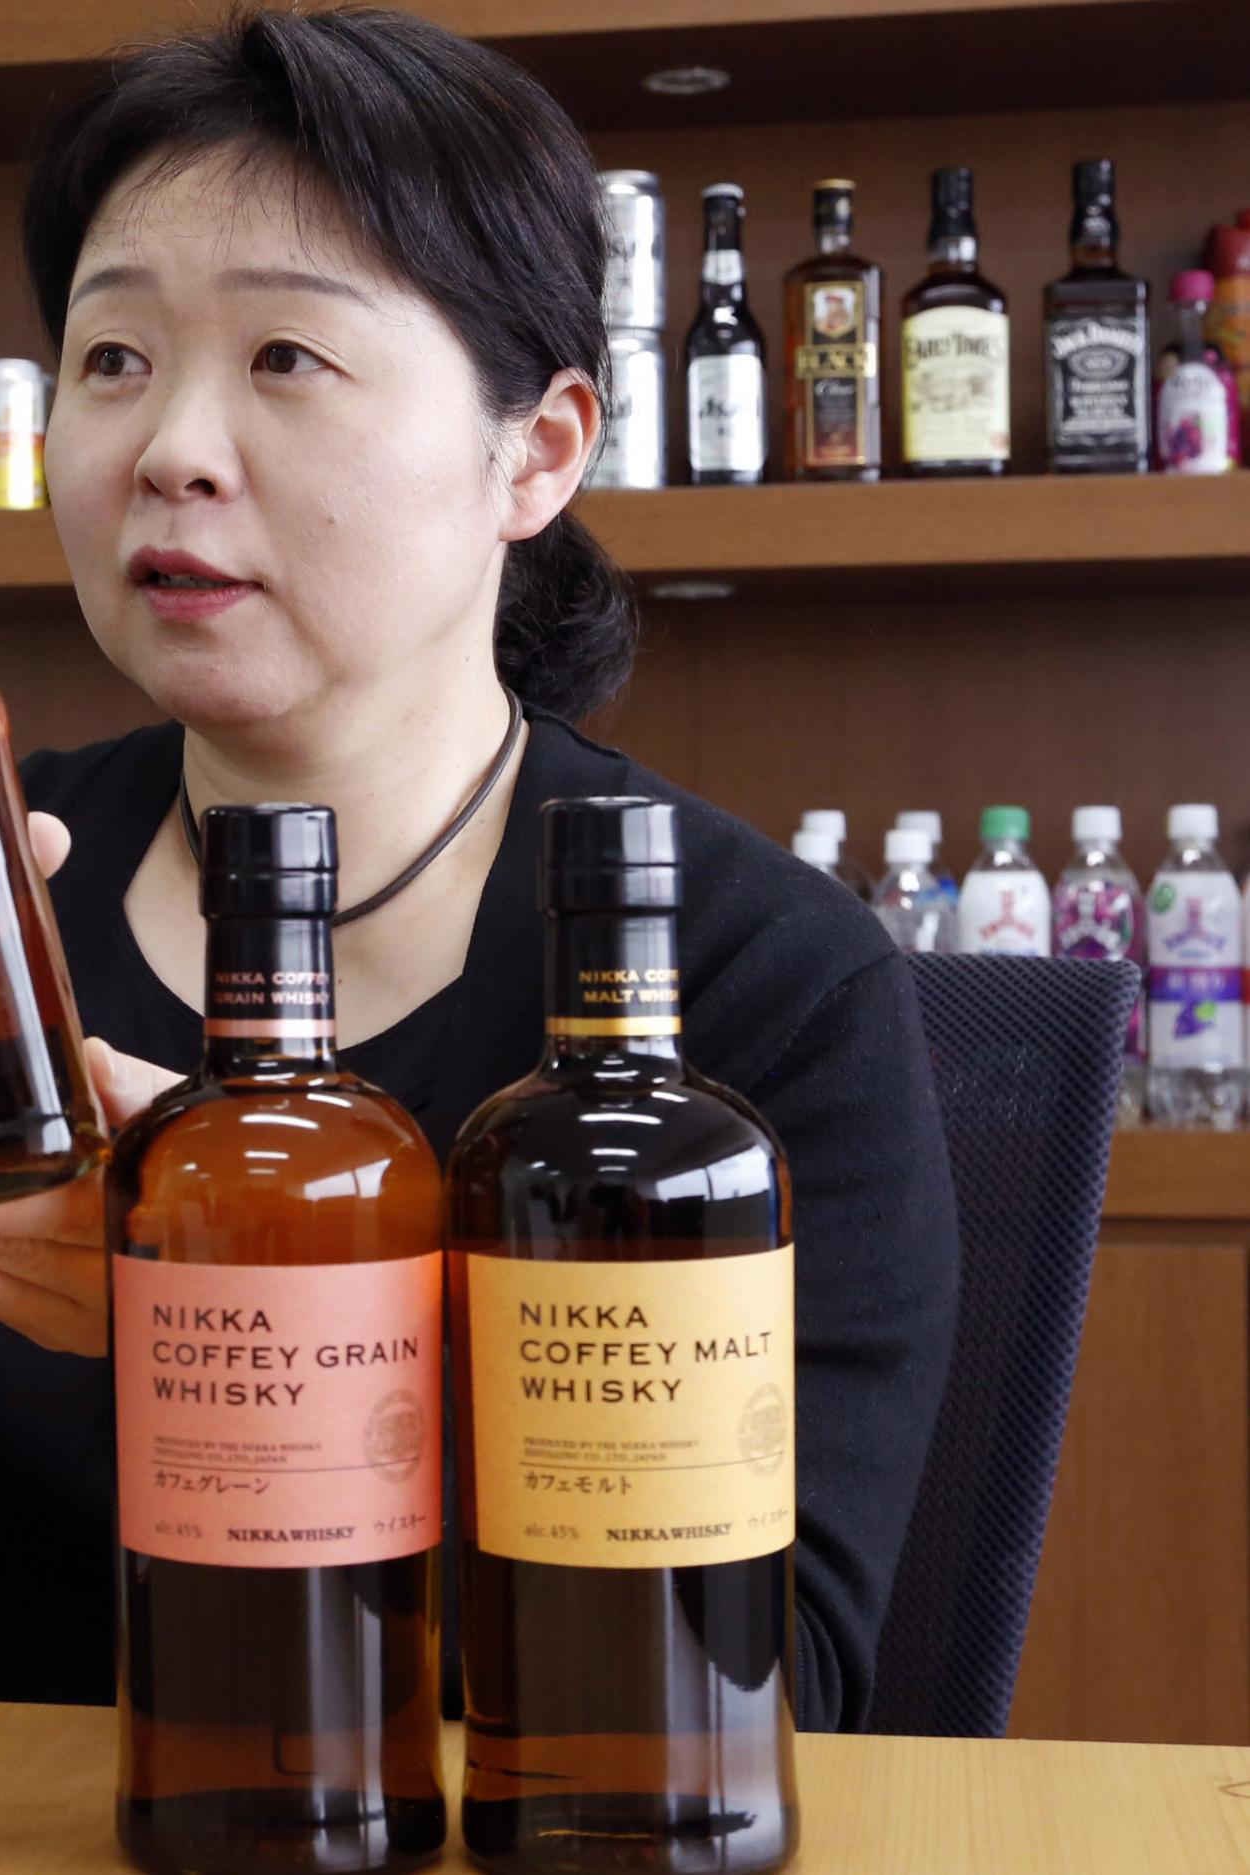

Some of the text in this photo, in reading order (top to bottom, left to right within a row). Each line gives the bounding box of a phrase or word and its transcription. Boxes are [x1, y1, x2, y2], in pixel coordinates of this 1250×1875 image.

[578, 969, 640, 982] NIKKA
[583, 990, 634, 1003] MALT
[153, 1304, 272, 1332] NIKKA
[520, 1302, 649, 1329] NIKKA
[152, 1336, 419, 1369] COFFEY GRAIN
[519, 1331, 772, 1366] COFFEY MALT
[153, 1376, 305, 1406] WHISKY
[521, 1376, 682, 1403] WHISKY
[154, 1470, 270, 1495] カフェグレーン
[524, 1471, 632, 1495] カフェモルト
[227, 1526, 356, 1542] NIKKA WHISKY
[373, 1512, 427, 1536] ウイスキー
[606, 1523, 733, 1541] NIKKA WHISKY
